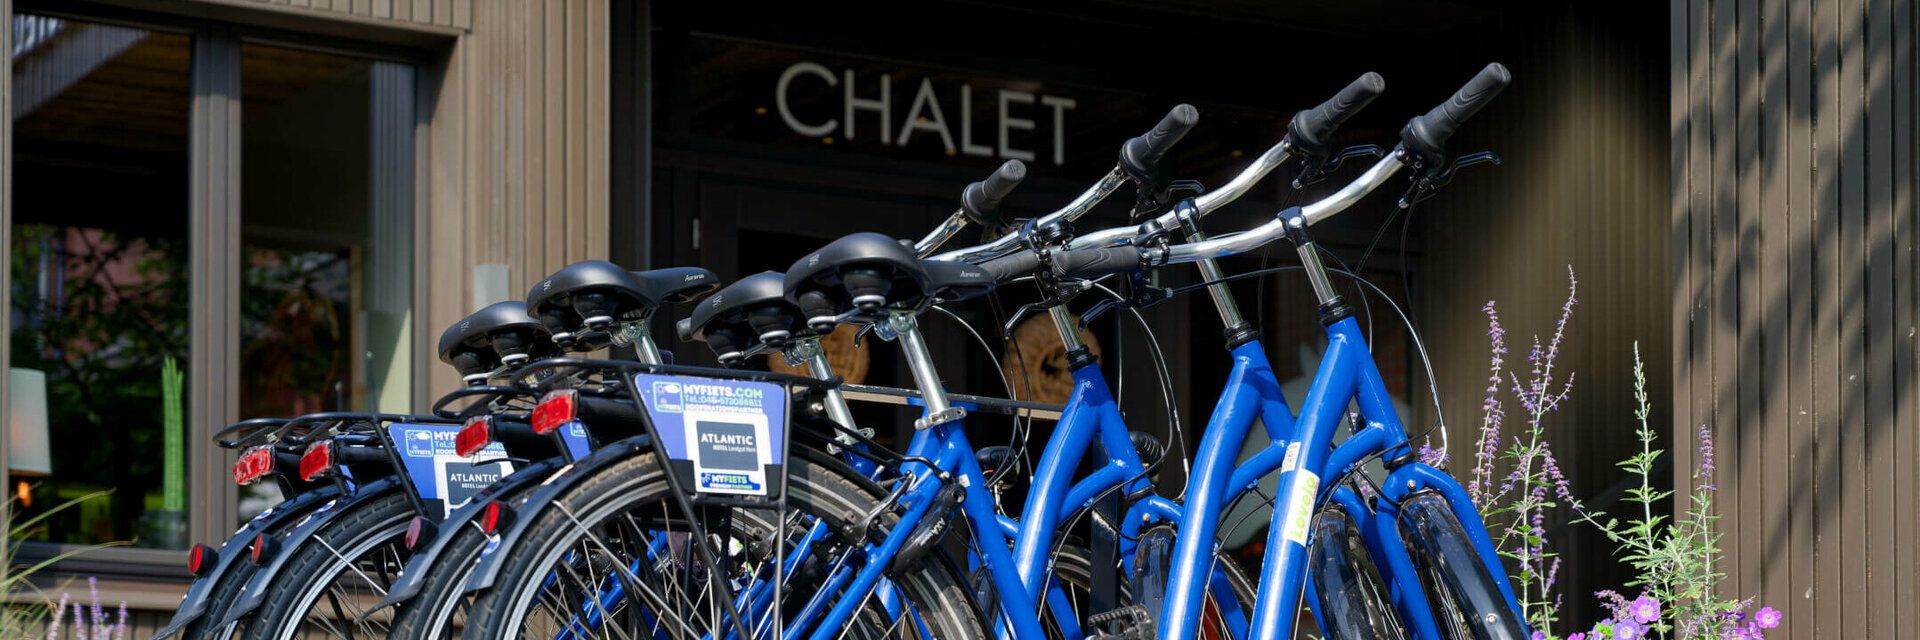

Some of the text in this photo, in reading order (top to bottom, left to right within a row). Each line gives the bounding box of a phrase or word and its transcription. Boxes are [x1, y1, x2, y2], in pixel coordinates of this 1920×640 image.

[776, 62, 1076, 165] CHALET
[683, 384, 763, 399] MYFIETS.COM
[701, 433, 753, 445] ATLANTIC
[450, 473, 499, 482] ATLANTIC
[711, 474, 748, 484] MYFIETS
[1291, 476, 1316, 539] Lovelo
